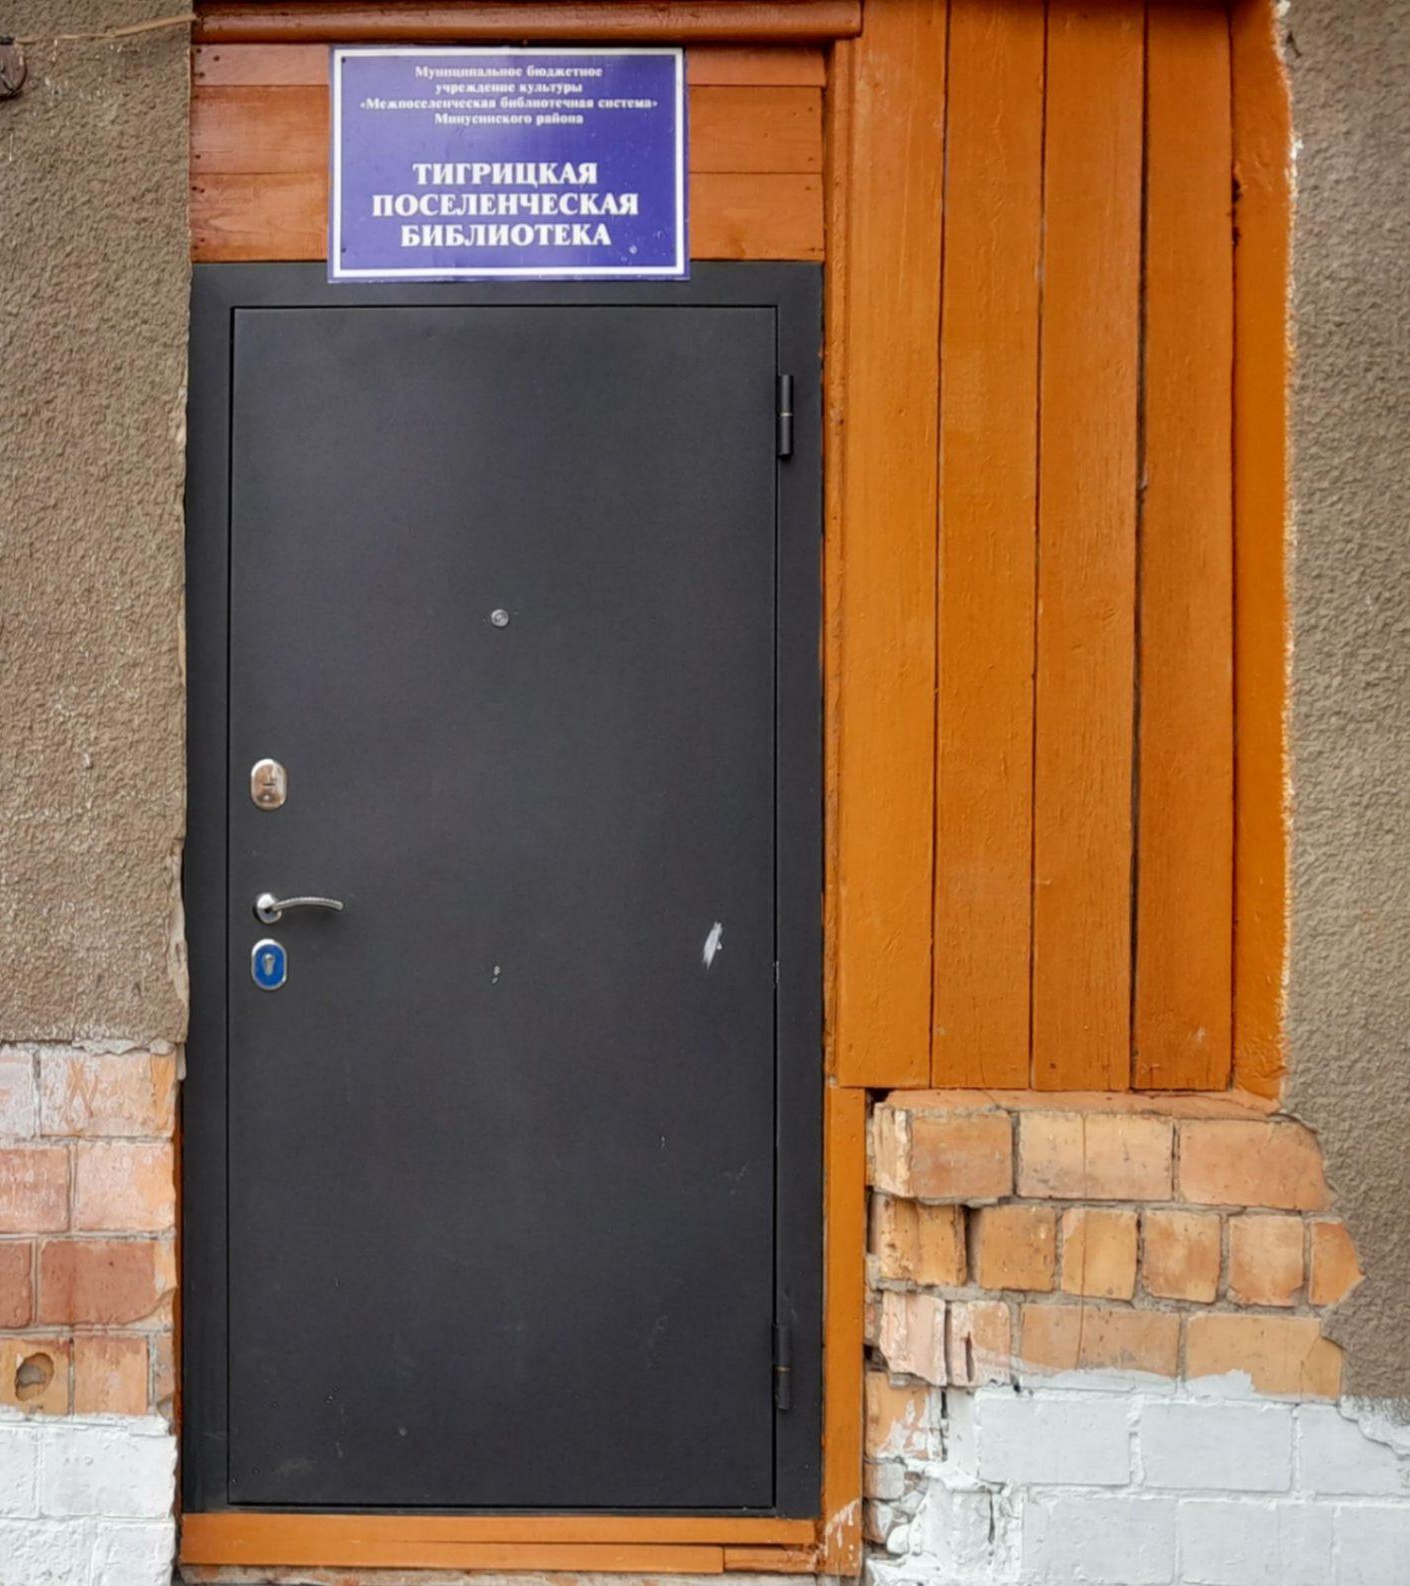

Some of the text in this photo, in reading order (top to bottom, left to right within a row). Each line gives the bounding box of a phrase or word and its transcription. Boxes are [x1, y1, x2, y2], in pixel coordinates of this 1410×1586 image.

[415, 65, 603, 79] Муниципальное бюджетное
[435, 83, 583, 95] учреждение культуры
[500, 97, 594, 109] библиотечная
[434, 113, 584, 126] Минусинского района
[412, 162, 598, 188] ТИГРИЦКАЯ
[372, 193, 639, 217] ПОСЕЛЕНЧЕСКАЯ
[401, 223, 612, 247] БИБЛИОТЕКА
